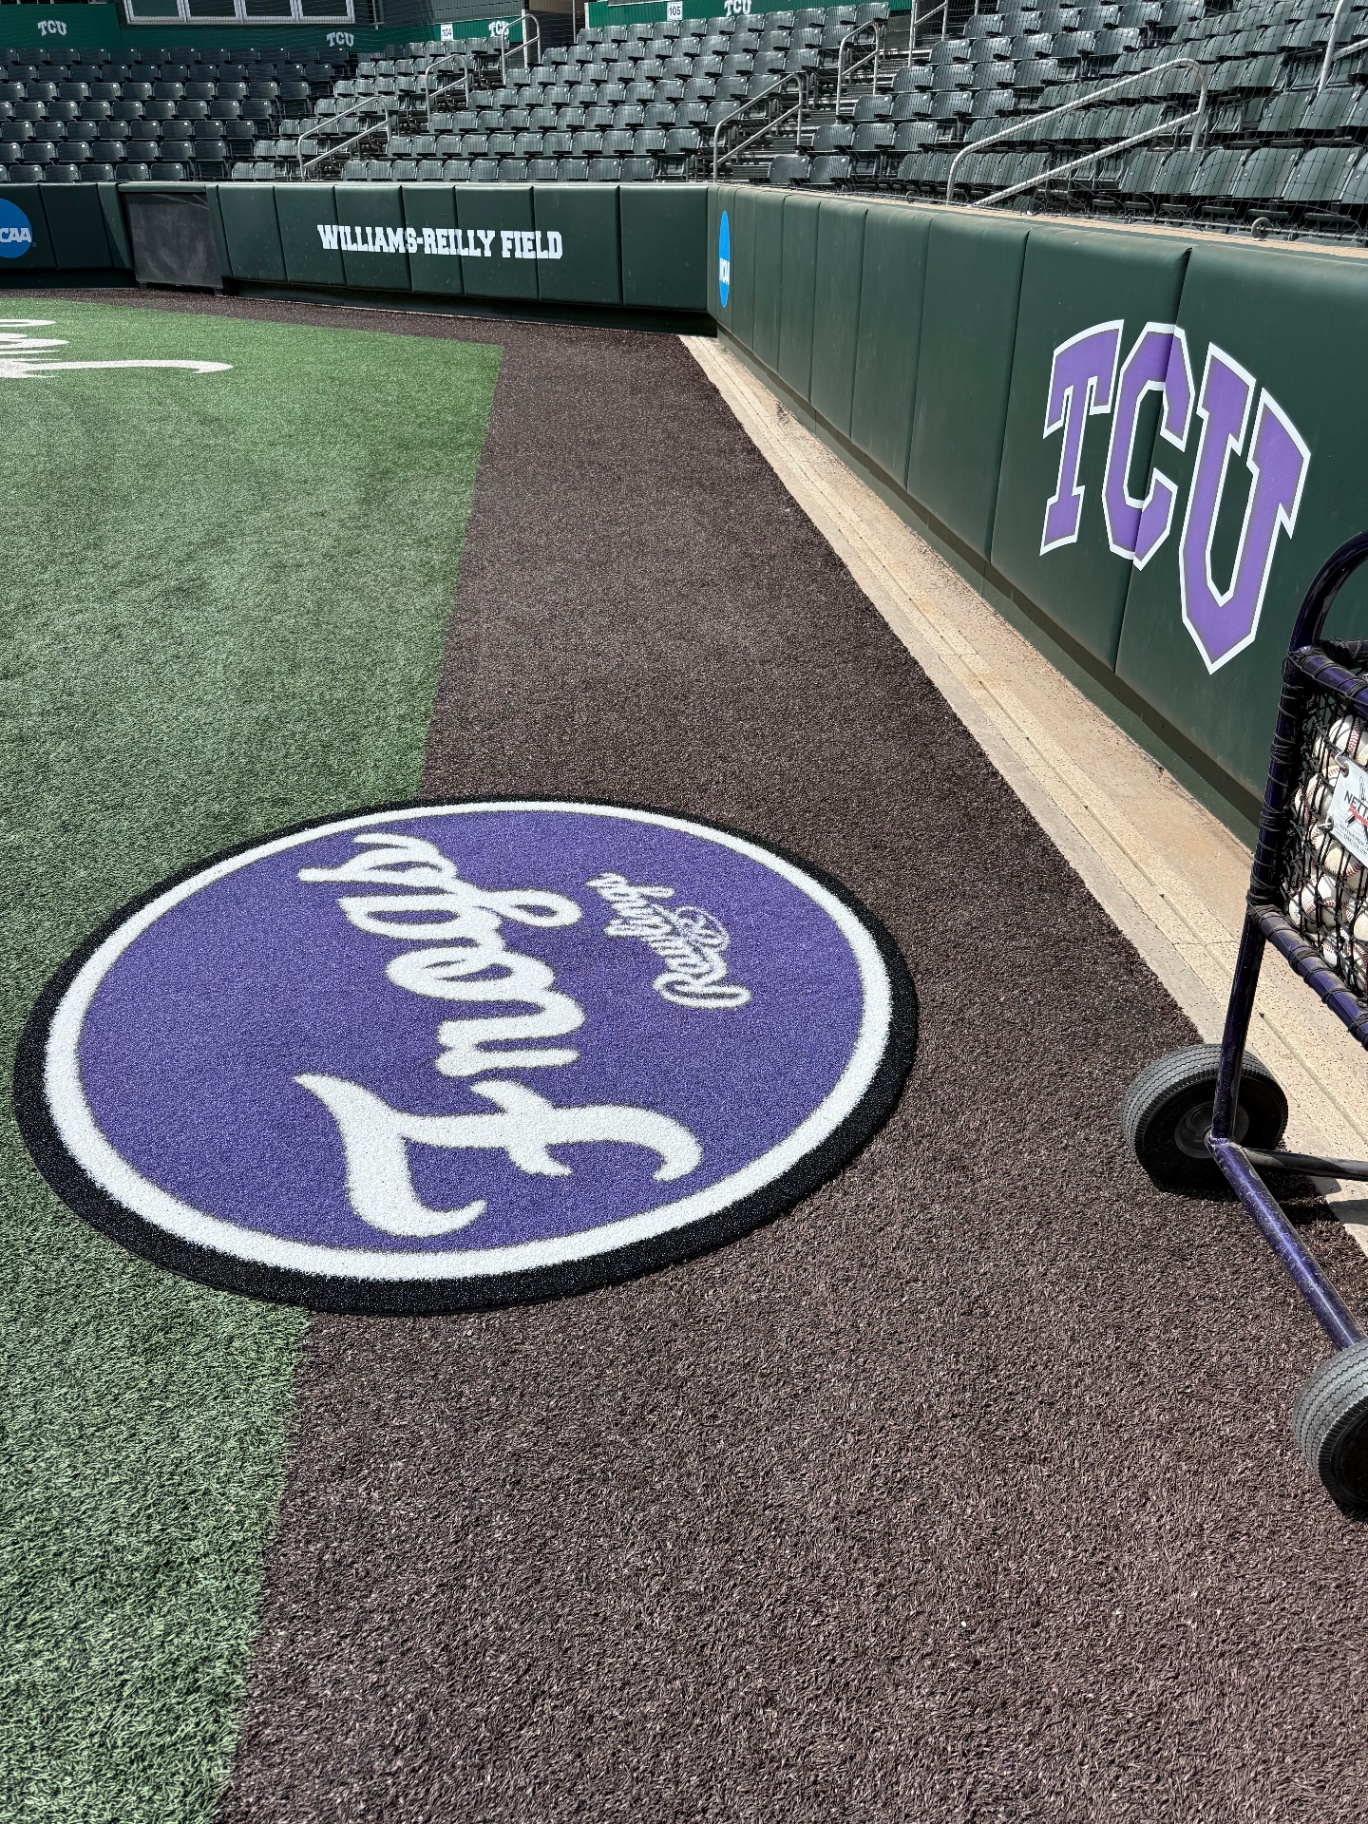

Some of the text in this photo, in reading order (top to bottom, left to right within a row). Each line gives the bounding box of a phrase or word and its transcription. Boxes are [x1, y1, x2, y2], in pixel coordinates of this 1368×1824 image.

[668, 6, 681, 16] 105
[724, 0, 752, 17] TCU
[37, 20, 67, 36] TCU
[488, 21, 510, 37] TCU
[326, 31, 355, 47] TCU
[0, 227, 32, 243] CAA
[317, 224, 563, 259] WILLIAMS-REILLY FIELD
[1039, 318, 1311, 675] TCU
[1343, 790, 1368, 821] NETT
[585, 871, 752, 1009] Rawlings
[292, 832, 703, 1239] Frogs
